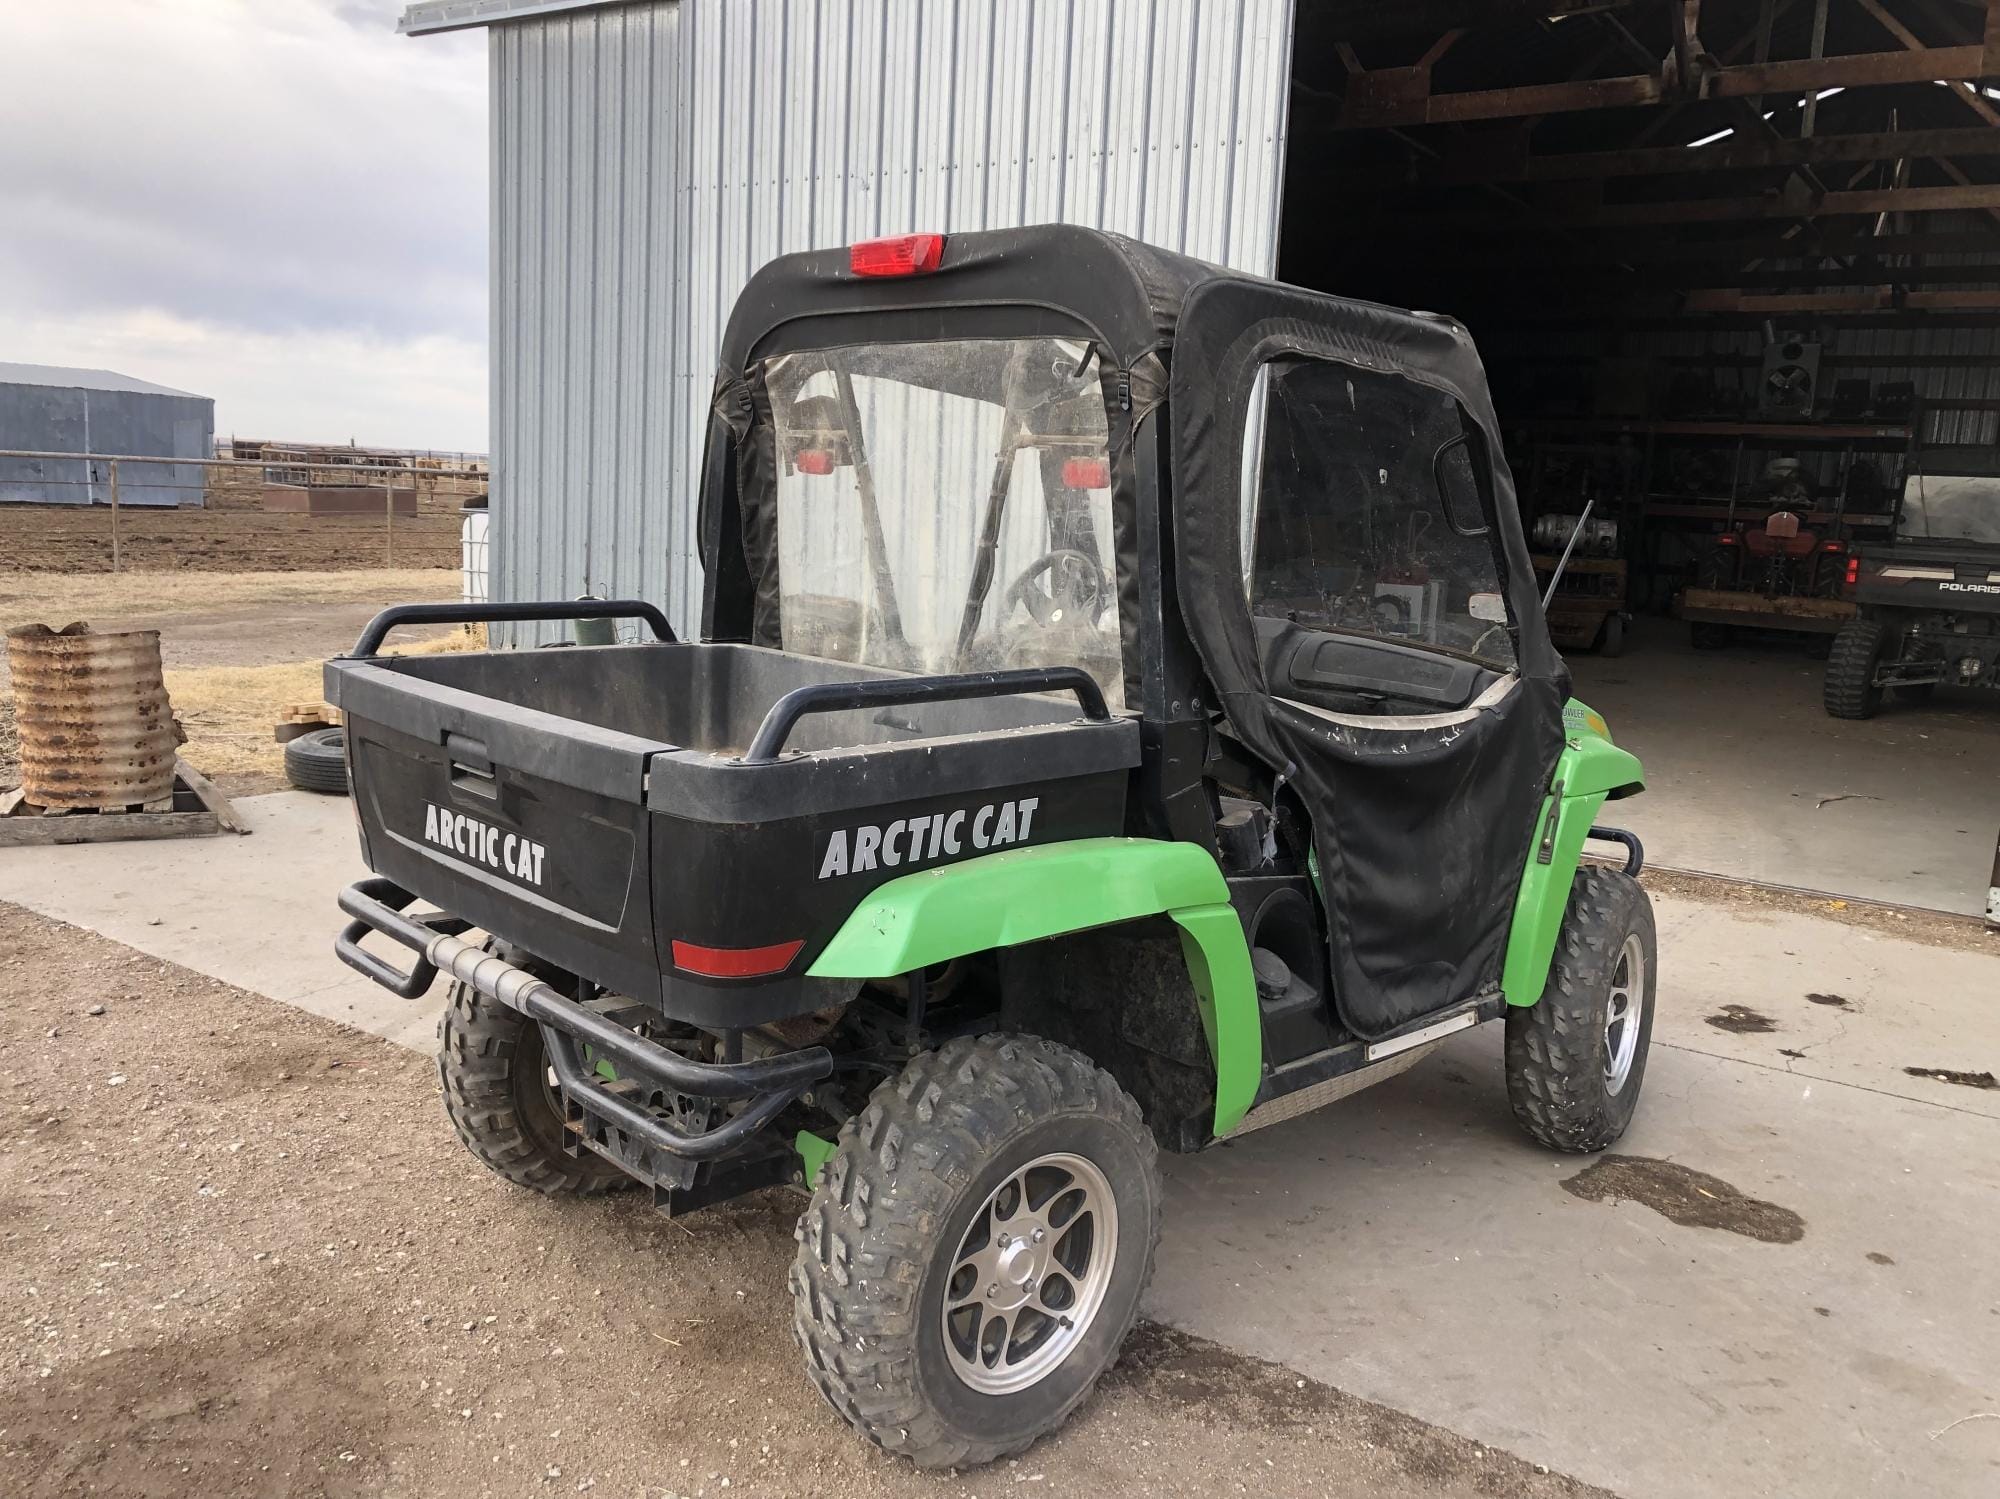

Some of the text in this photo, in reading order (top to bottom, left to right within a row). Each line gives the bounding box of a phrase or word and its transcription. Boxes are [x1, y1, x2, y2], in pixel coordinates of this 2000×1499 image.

[1939, 582, 2000, 594] POLARIS
[425, 804, 545, 886] ARCTIC CAT
[818, 797, 1039, 880] ARCTIC CAT
